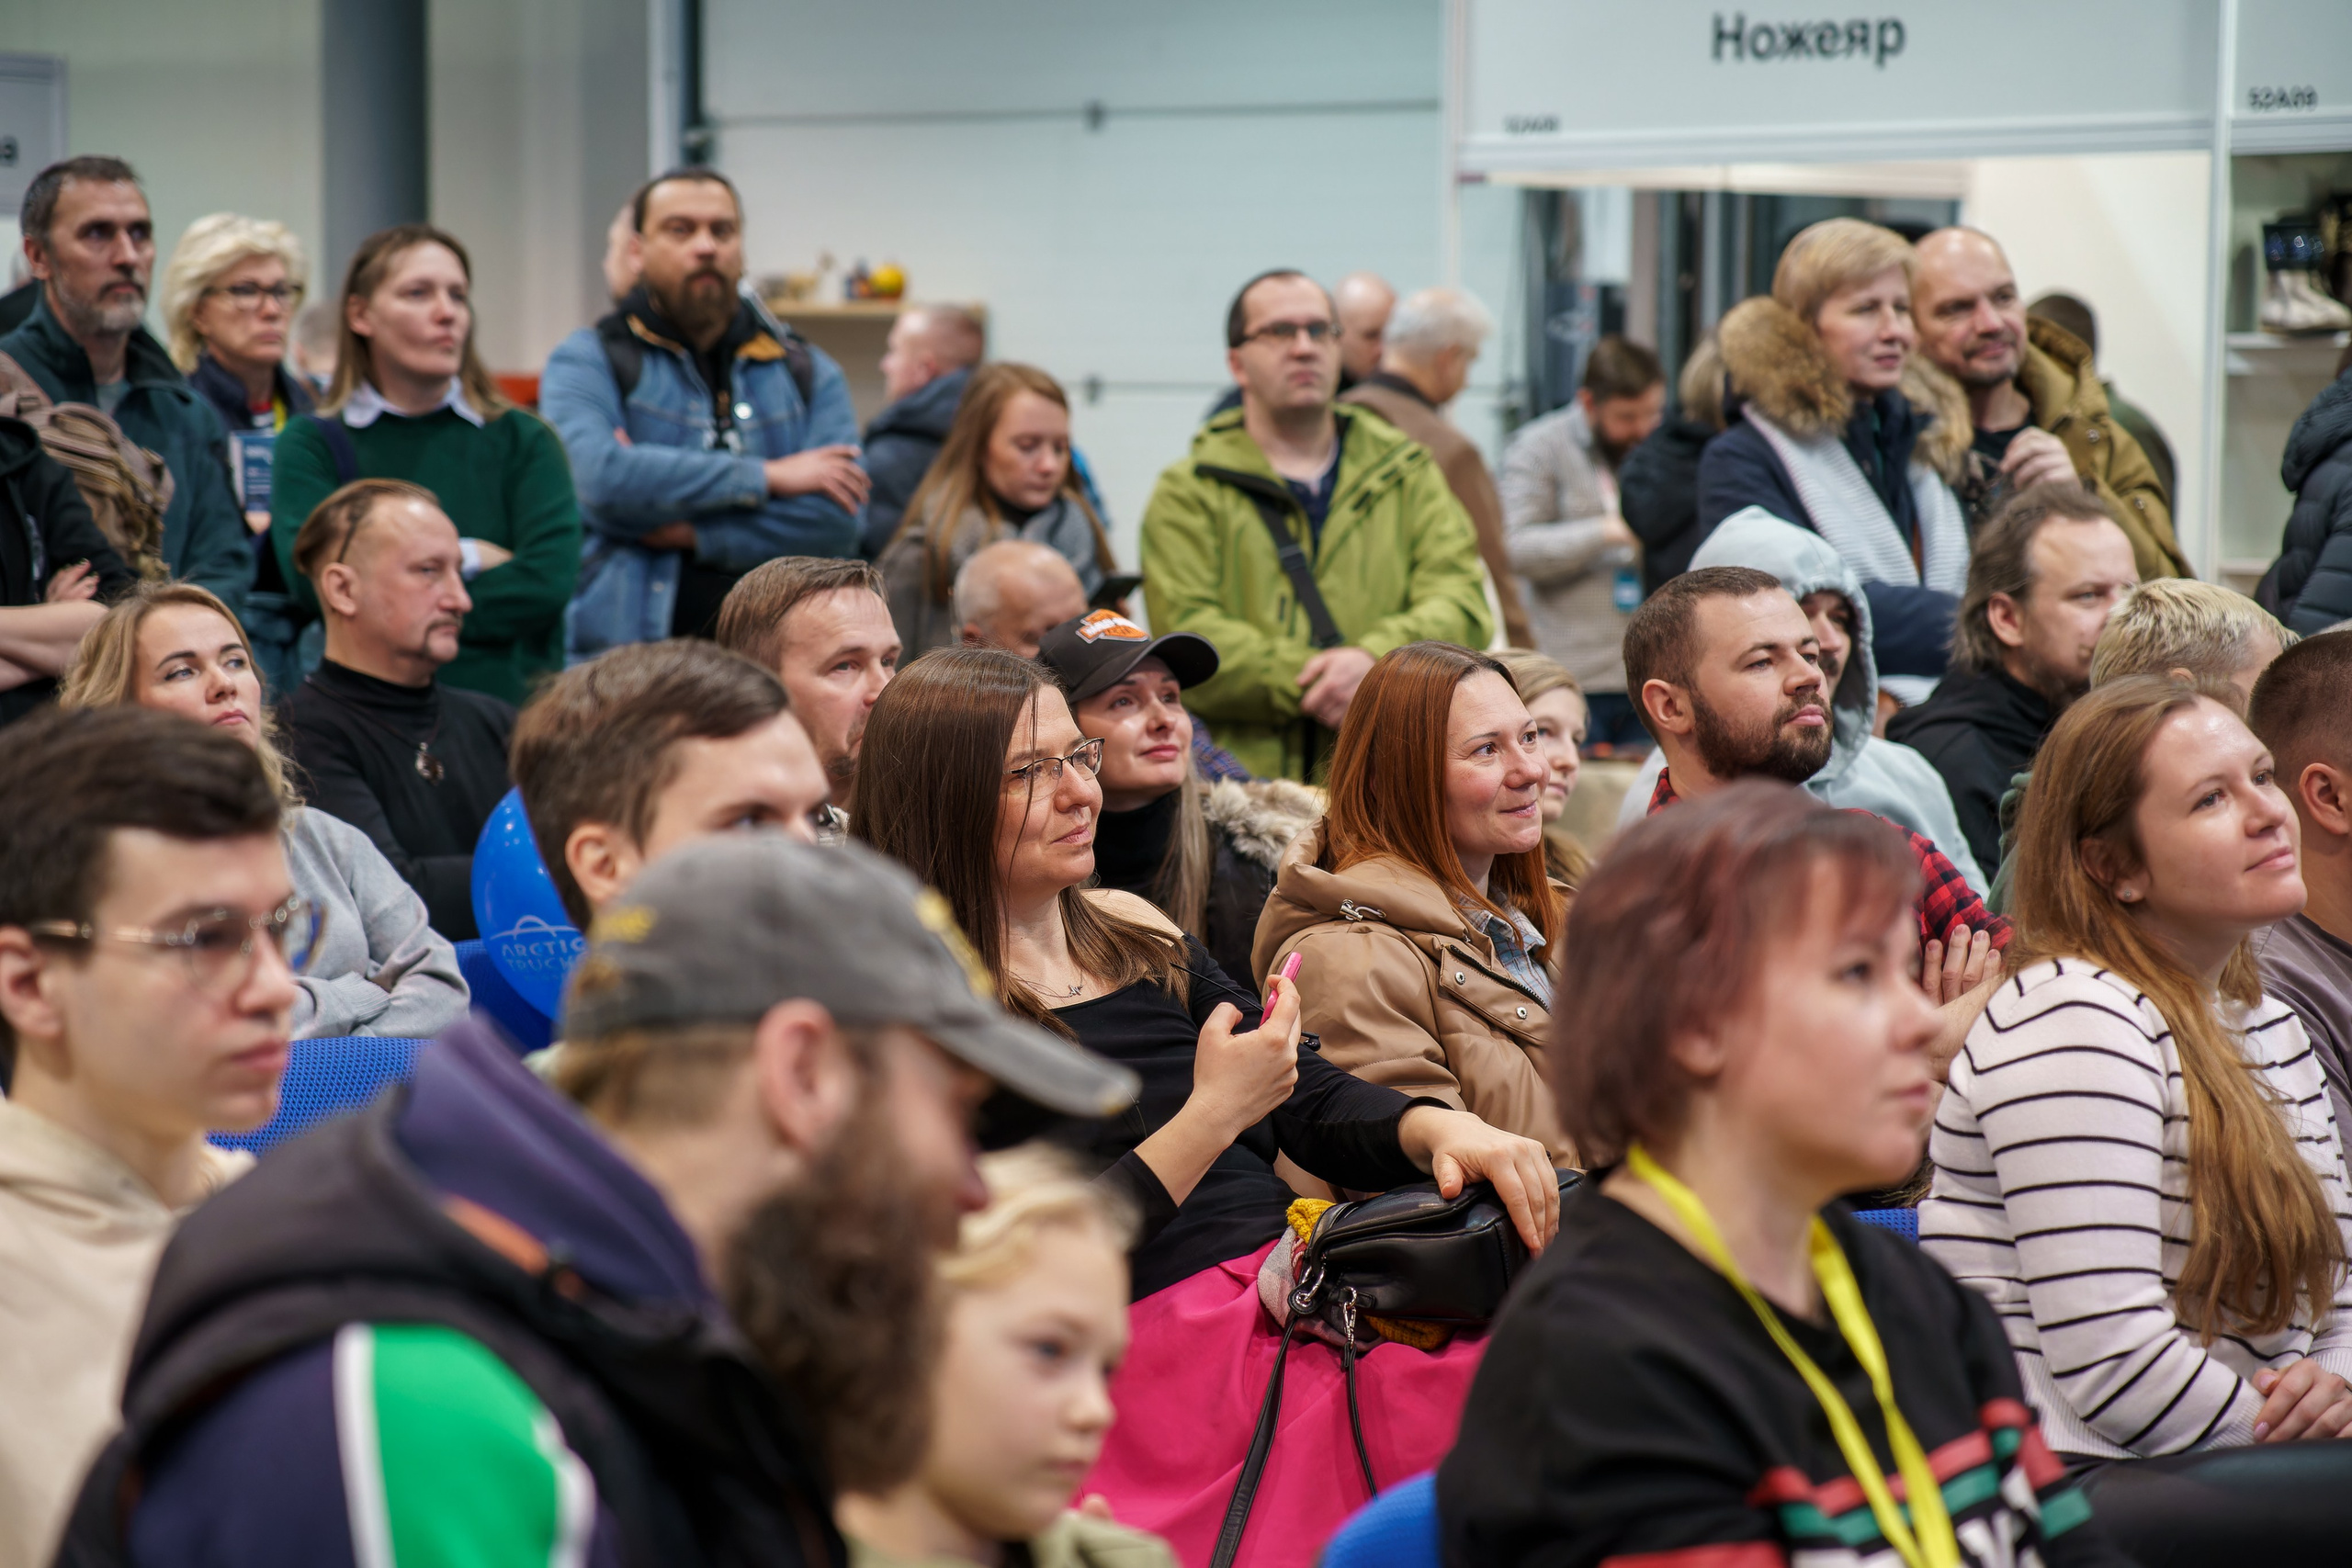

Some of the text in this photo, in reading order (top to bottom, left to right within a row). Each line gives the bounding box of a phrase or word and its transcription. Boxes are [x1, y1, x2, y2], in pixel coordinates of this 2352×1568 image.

[1711, 12, 1905, 69] Ножеяр
[502, 936, 587, 956] ARCTIC
[505, 953, 581, 972] TRUCK
